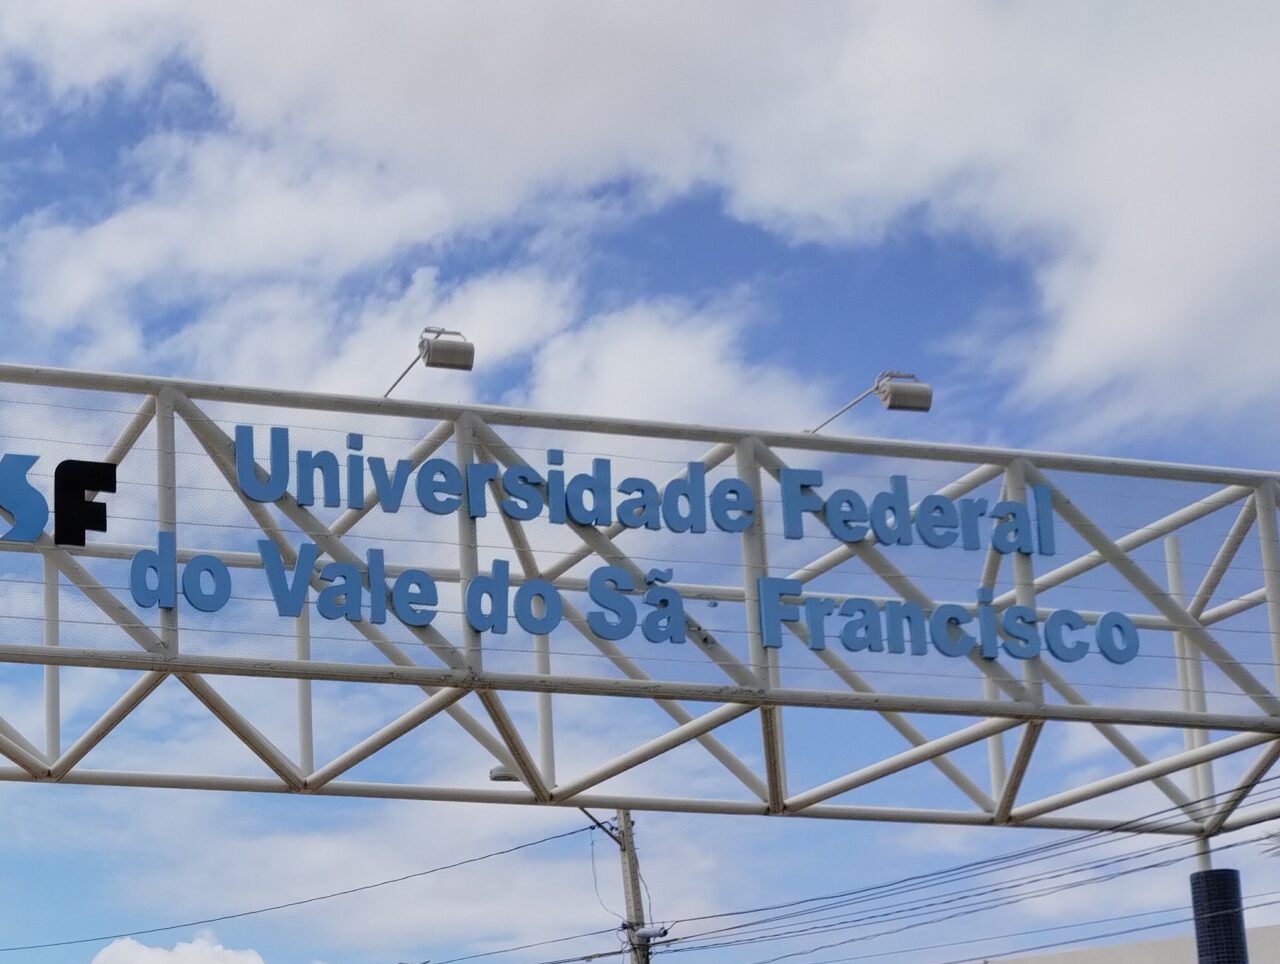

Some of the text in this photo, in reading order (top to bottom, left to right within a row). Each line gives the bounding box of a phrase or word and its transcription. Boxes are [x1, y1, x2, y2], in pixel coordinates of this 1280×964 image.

[235, 425, 1056, 556] Universidade Federal
[130, 532, 231, 612] do
[258, 539, 439, 627] Vale
[464, 559, 563, 635] do
[758, 577, 1140, 665] Francisco
